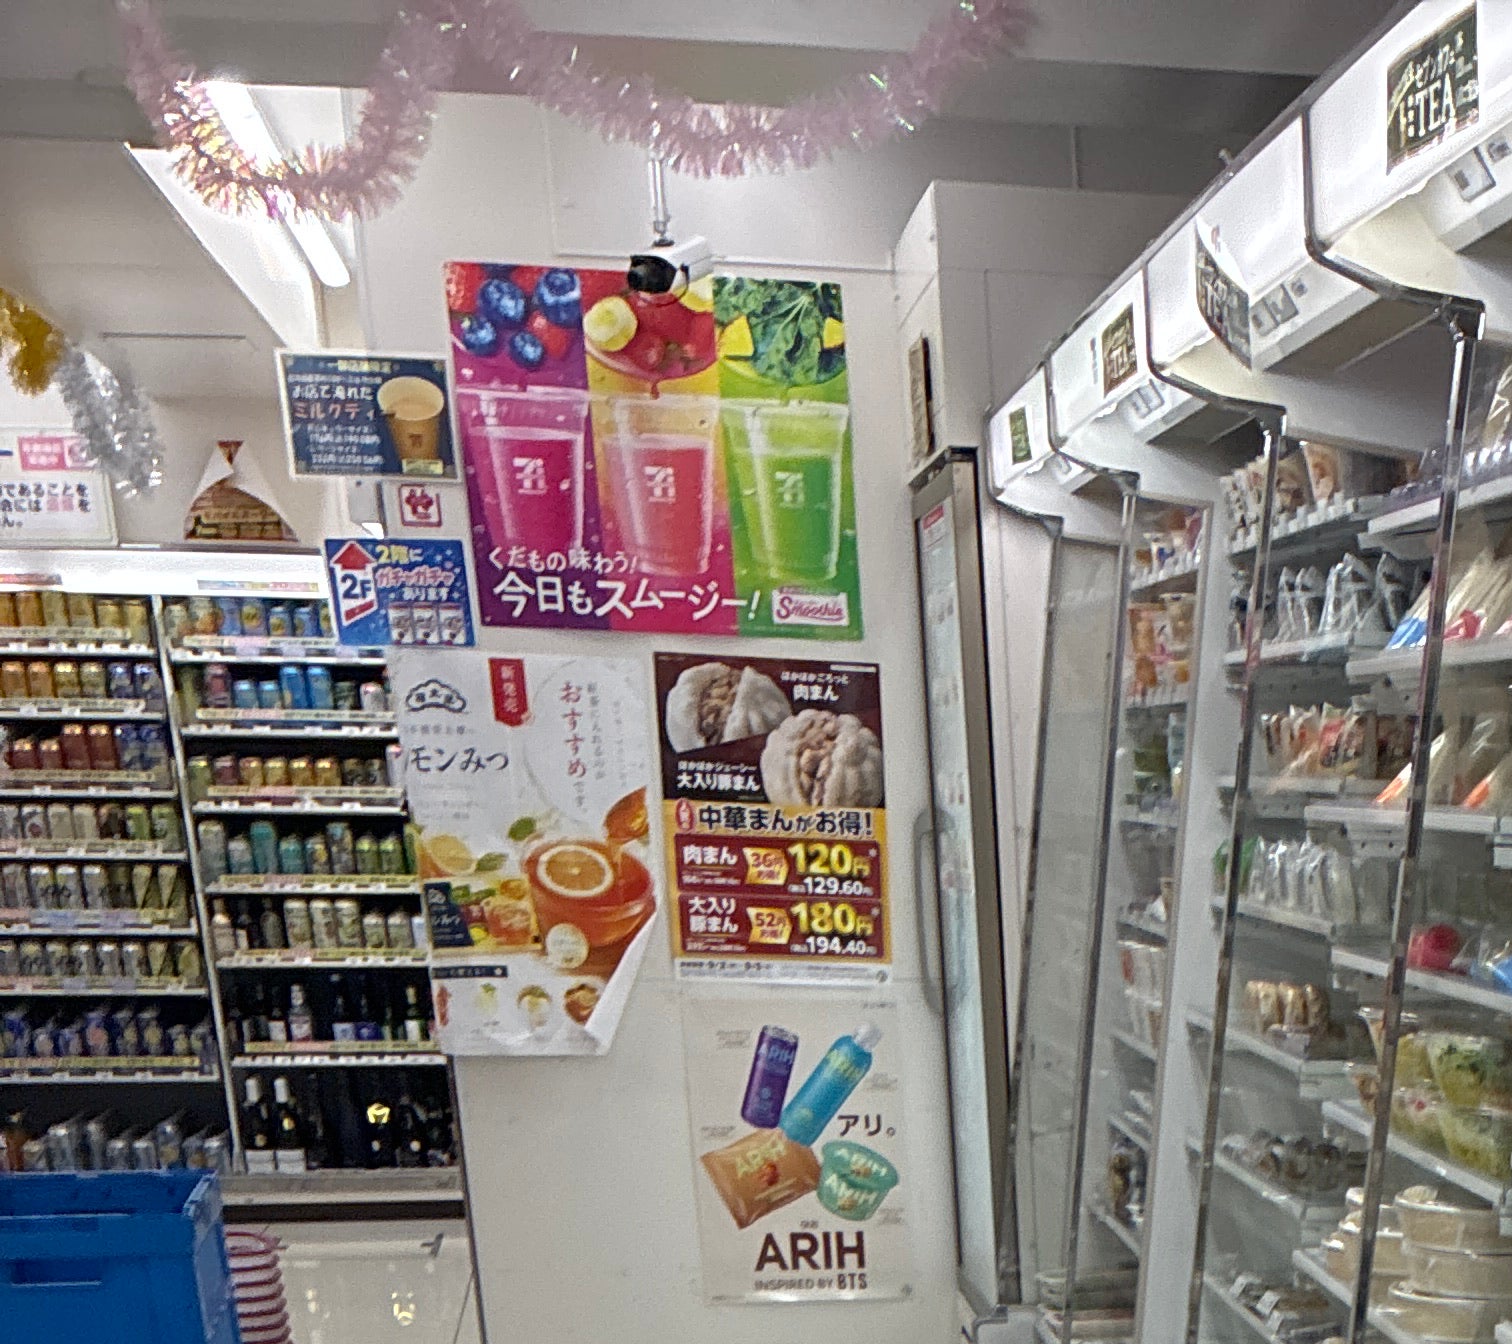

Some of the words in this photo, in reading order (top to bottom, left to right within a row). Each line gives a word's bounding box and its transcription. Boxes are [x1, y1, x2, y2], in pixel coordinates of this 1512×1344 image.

[488, 546, 638, 575] くだもの味わう!
[341, 573, 372, 600] 2F
[493, 571, 761, 621] 今日もスムージー!
[793, 684, 839, 701] 肉まん
[677, 773, 761, 791] 大入り豚まん
[700, 806, 873, 836] 中華まんがお得!
[683, 845, 738, 865] 肉まん
[689, 897, 736, 915] 大入り
[754, 1230, 867, 1272] ARIH
[754, 1277, 815, 1291] INSPIRED
[836, 1273, 868, 1290] BTS
